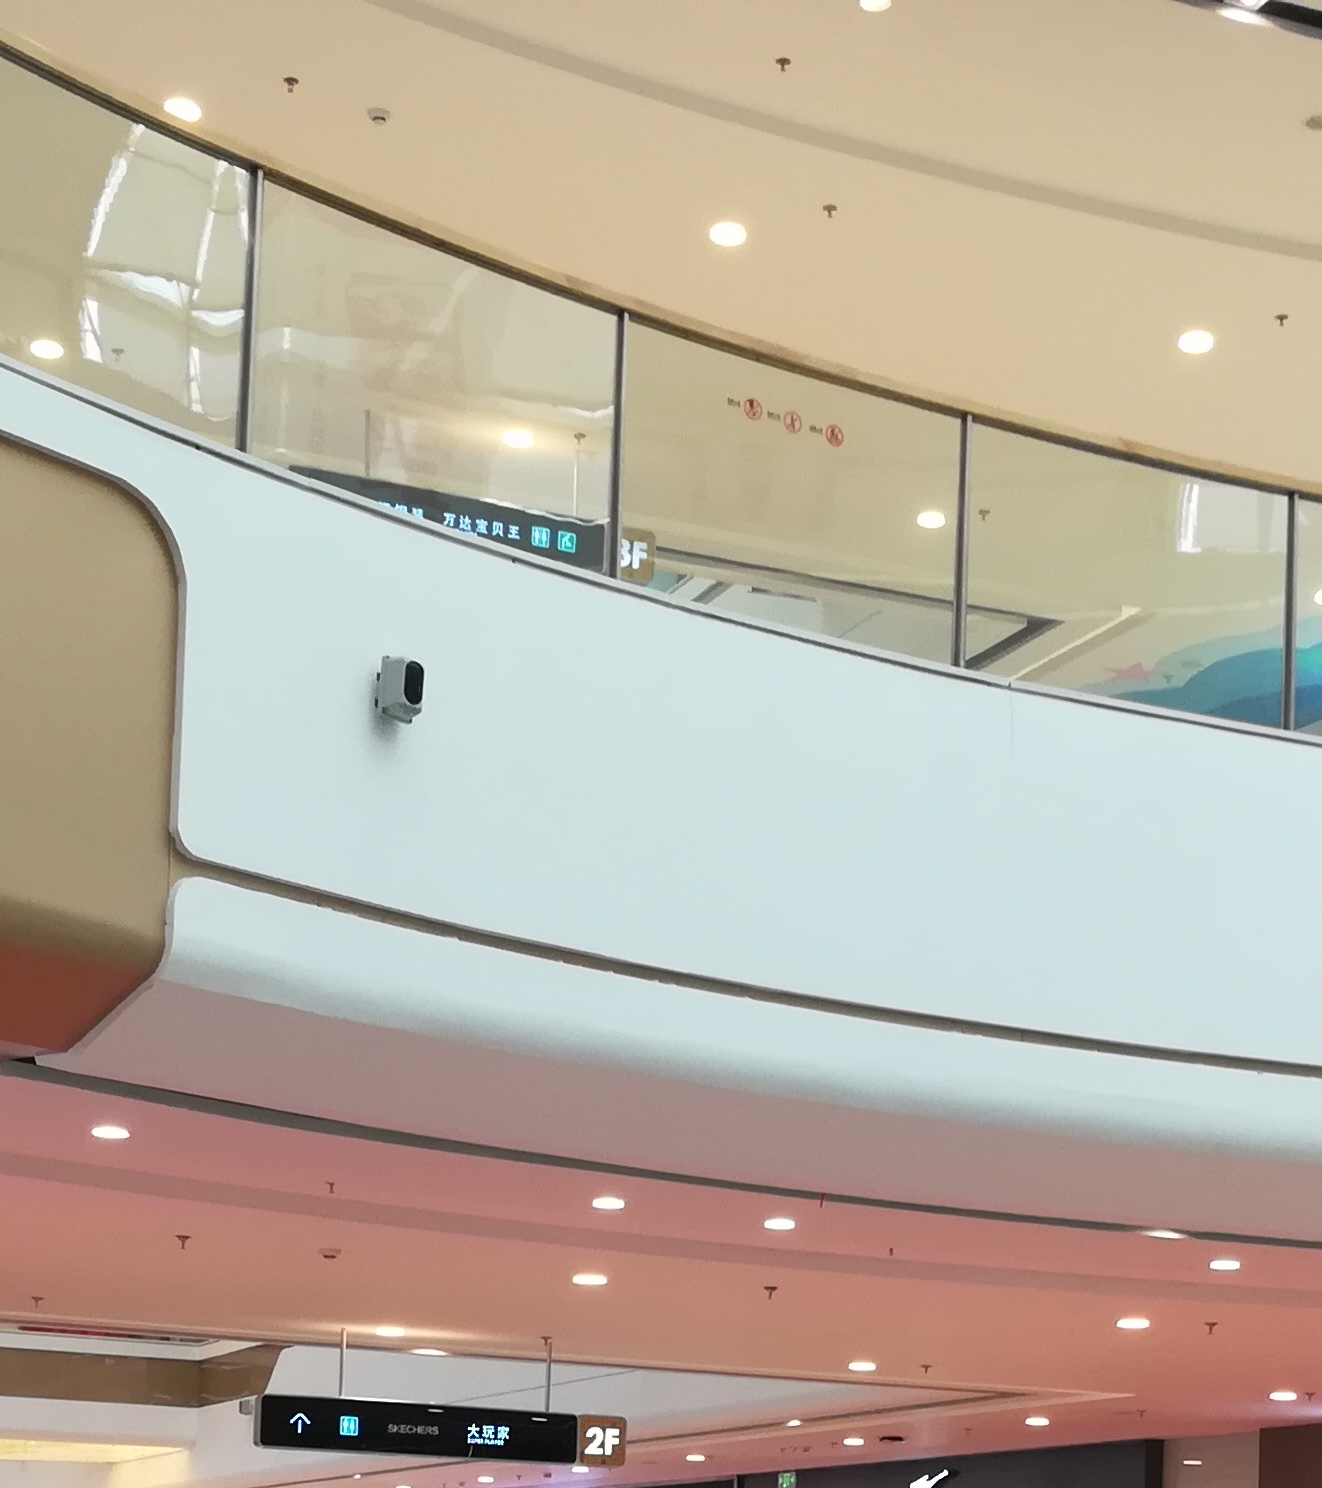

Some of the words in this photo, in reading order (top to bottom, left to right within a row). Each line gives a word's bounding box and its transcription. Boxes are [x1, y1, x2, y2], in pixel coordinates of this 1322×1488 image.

[443, 512, 521, 540] 万达宝贝王
[467, 1423, 510, 1440] 大玩家
[584, 1427, 621, 1456] 2F
